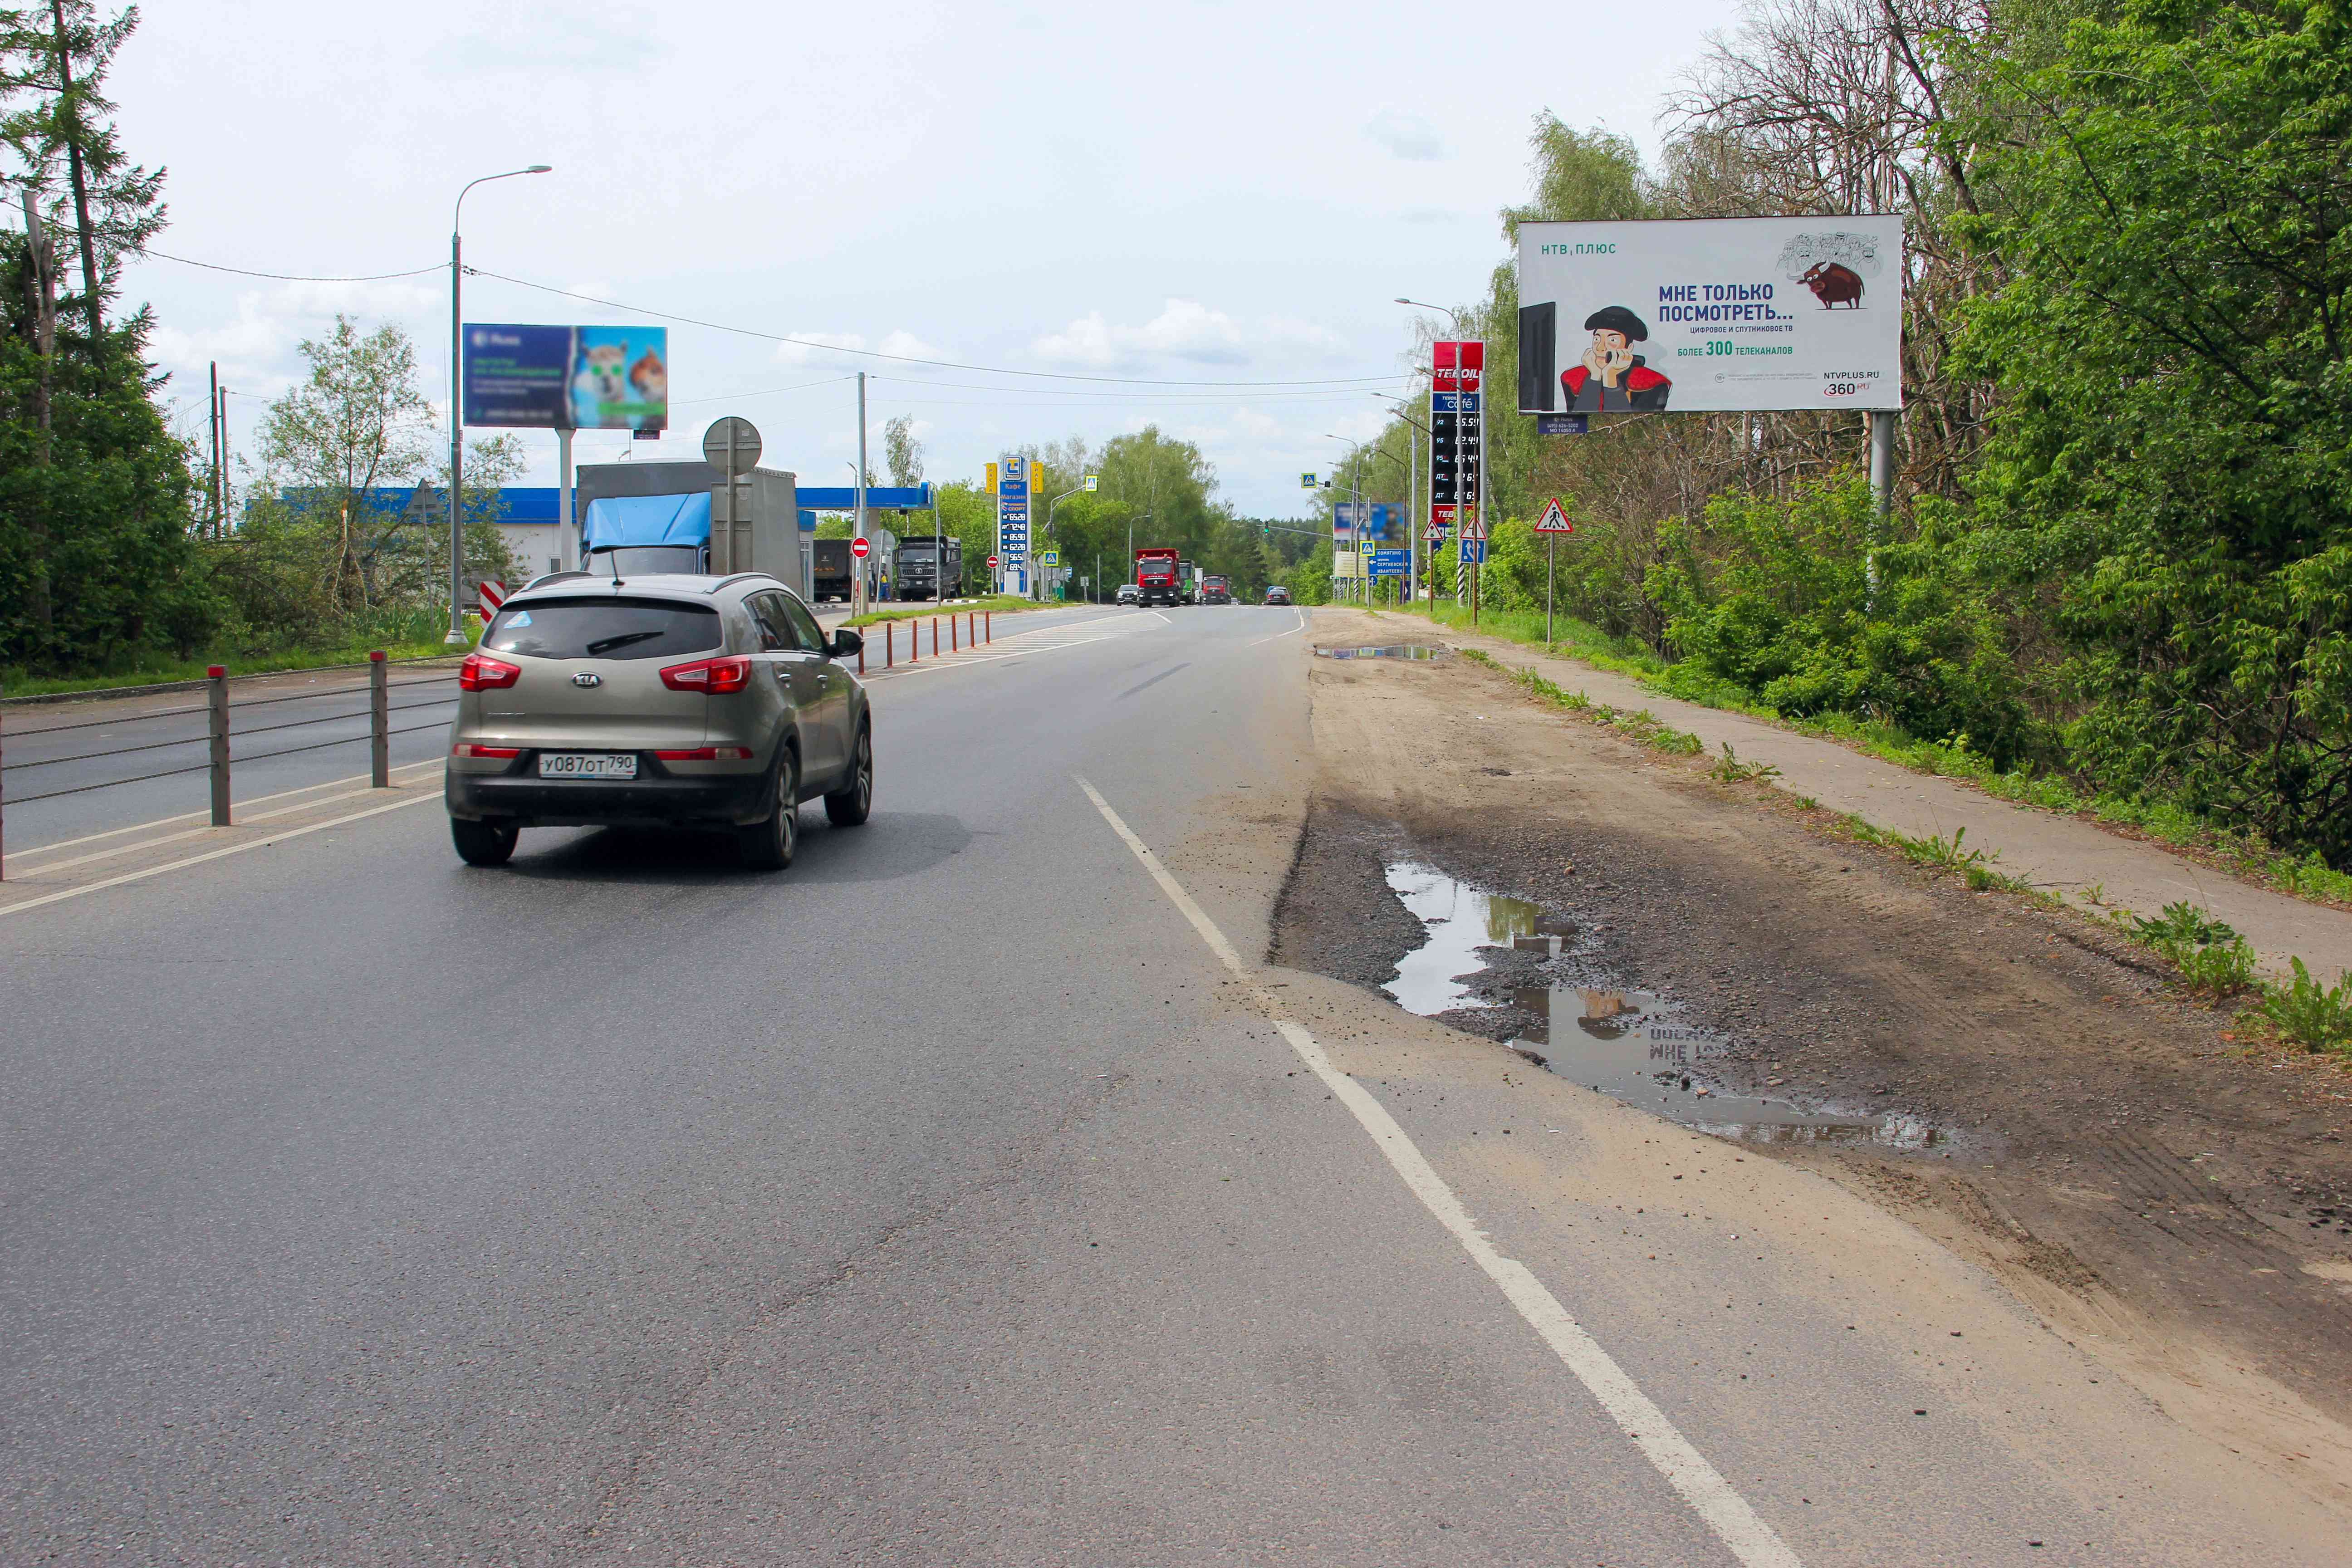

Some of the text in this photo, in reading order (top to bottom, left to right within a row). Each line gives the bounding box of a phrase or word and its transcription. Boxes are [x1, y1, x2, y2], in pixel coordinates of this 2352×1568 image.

[1542, 244, 1616, 255] НТВ ПЛЮС
[1659, 284, 1773, 302] МНЕ ТОЛЬКО
[1659, 304, 1793, 322] ПОСМОТРЕТЬ...
[1678, 341, 1793, 356] БОЛЕЕ 300 ТЕЛЕКАНАЛОВ
[1823, 371, 1879, 379] NTVPLUS.RU
[1828, 383, 1855, 395] 360
[575, 675, 598, 685] KIA
[608, 756, 632, 768] 790
